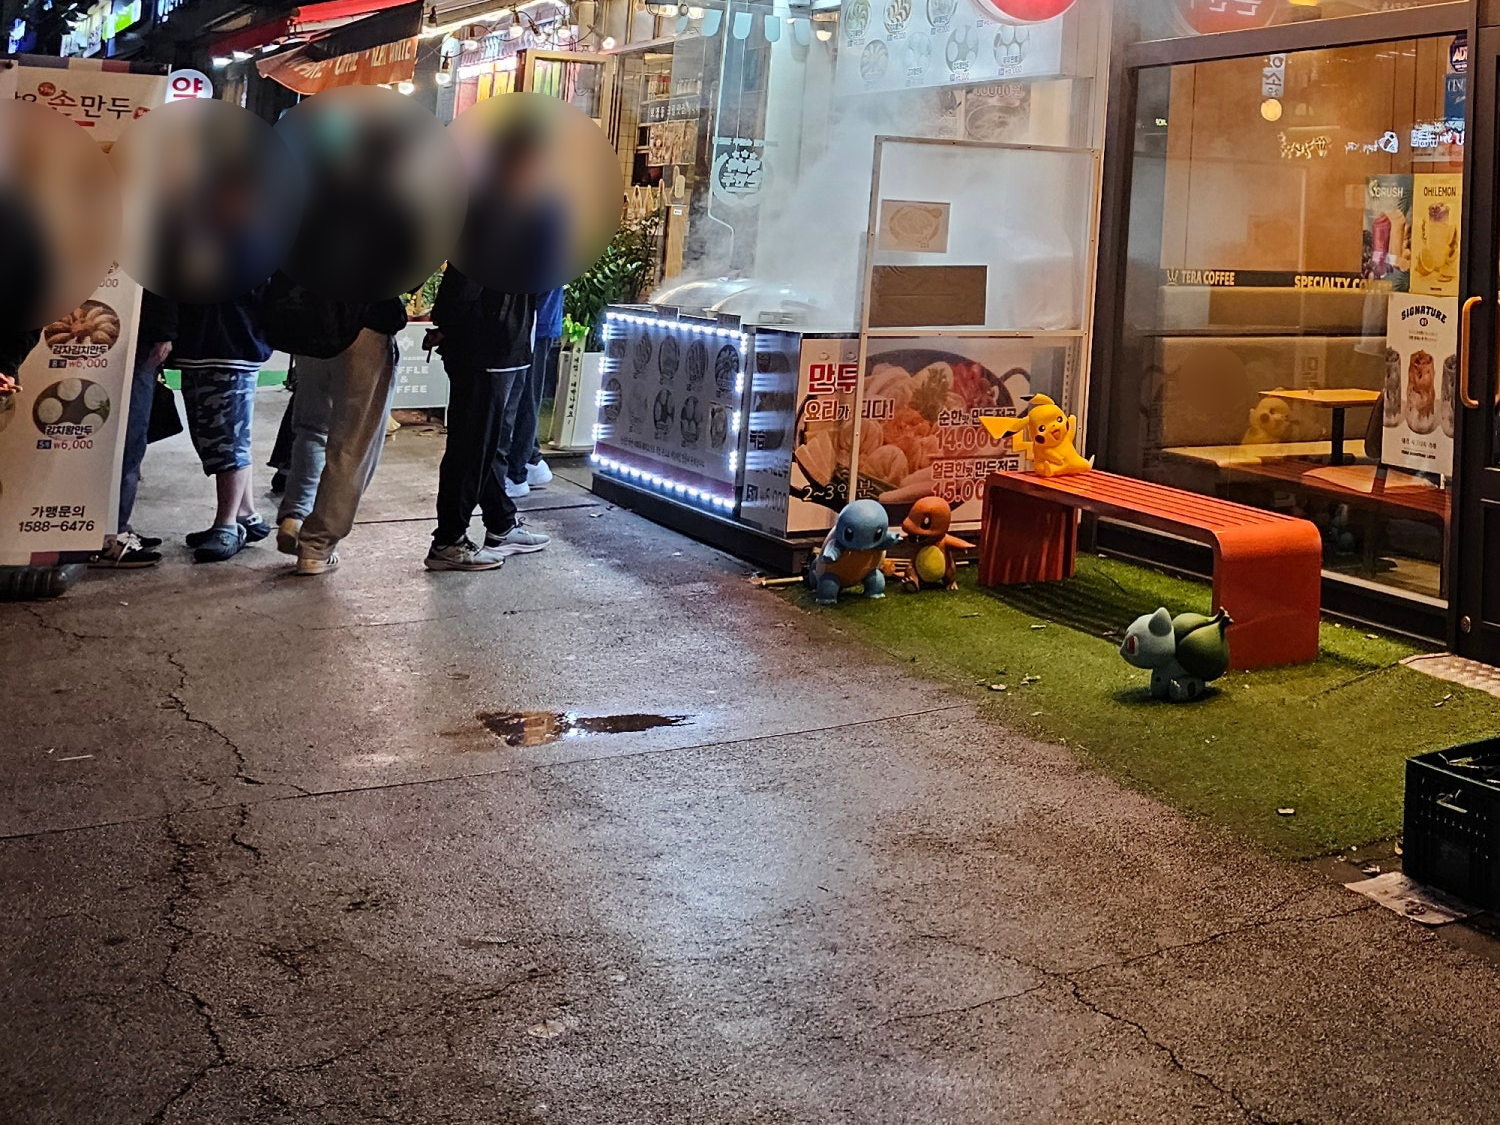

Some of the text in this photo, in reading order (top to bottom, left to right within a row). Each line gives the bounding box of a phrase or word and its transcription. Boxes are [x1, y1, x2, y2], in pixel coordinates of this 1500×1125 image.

[1181, 270, 1235, 286] TERA COFFEE
[1401, 304, 1447, 325] SIGNATURE
[31, 503, 85, 518] 가맹문의
[19, 519, 95, 534] 1588-6476
